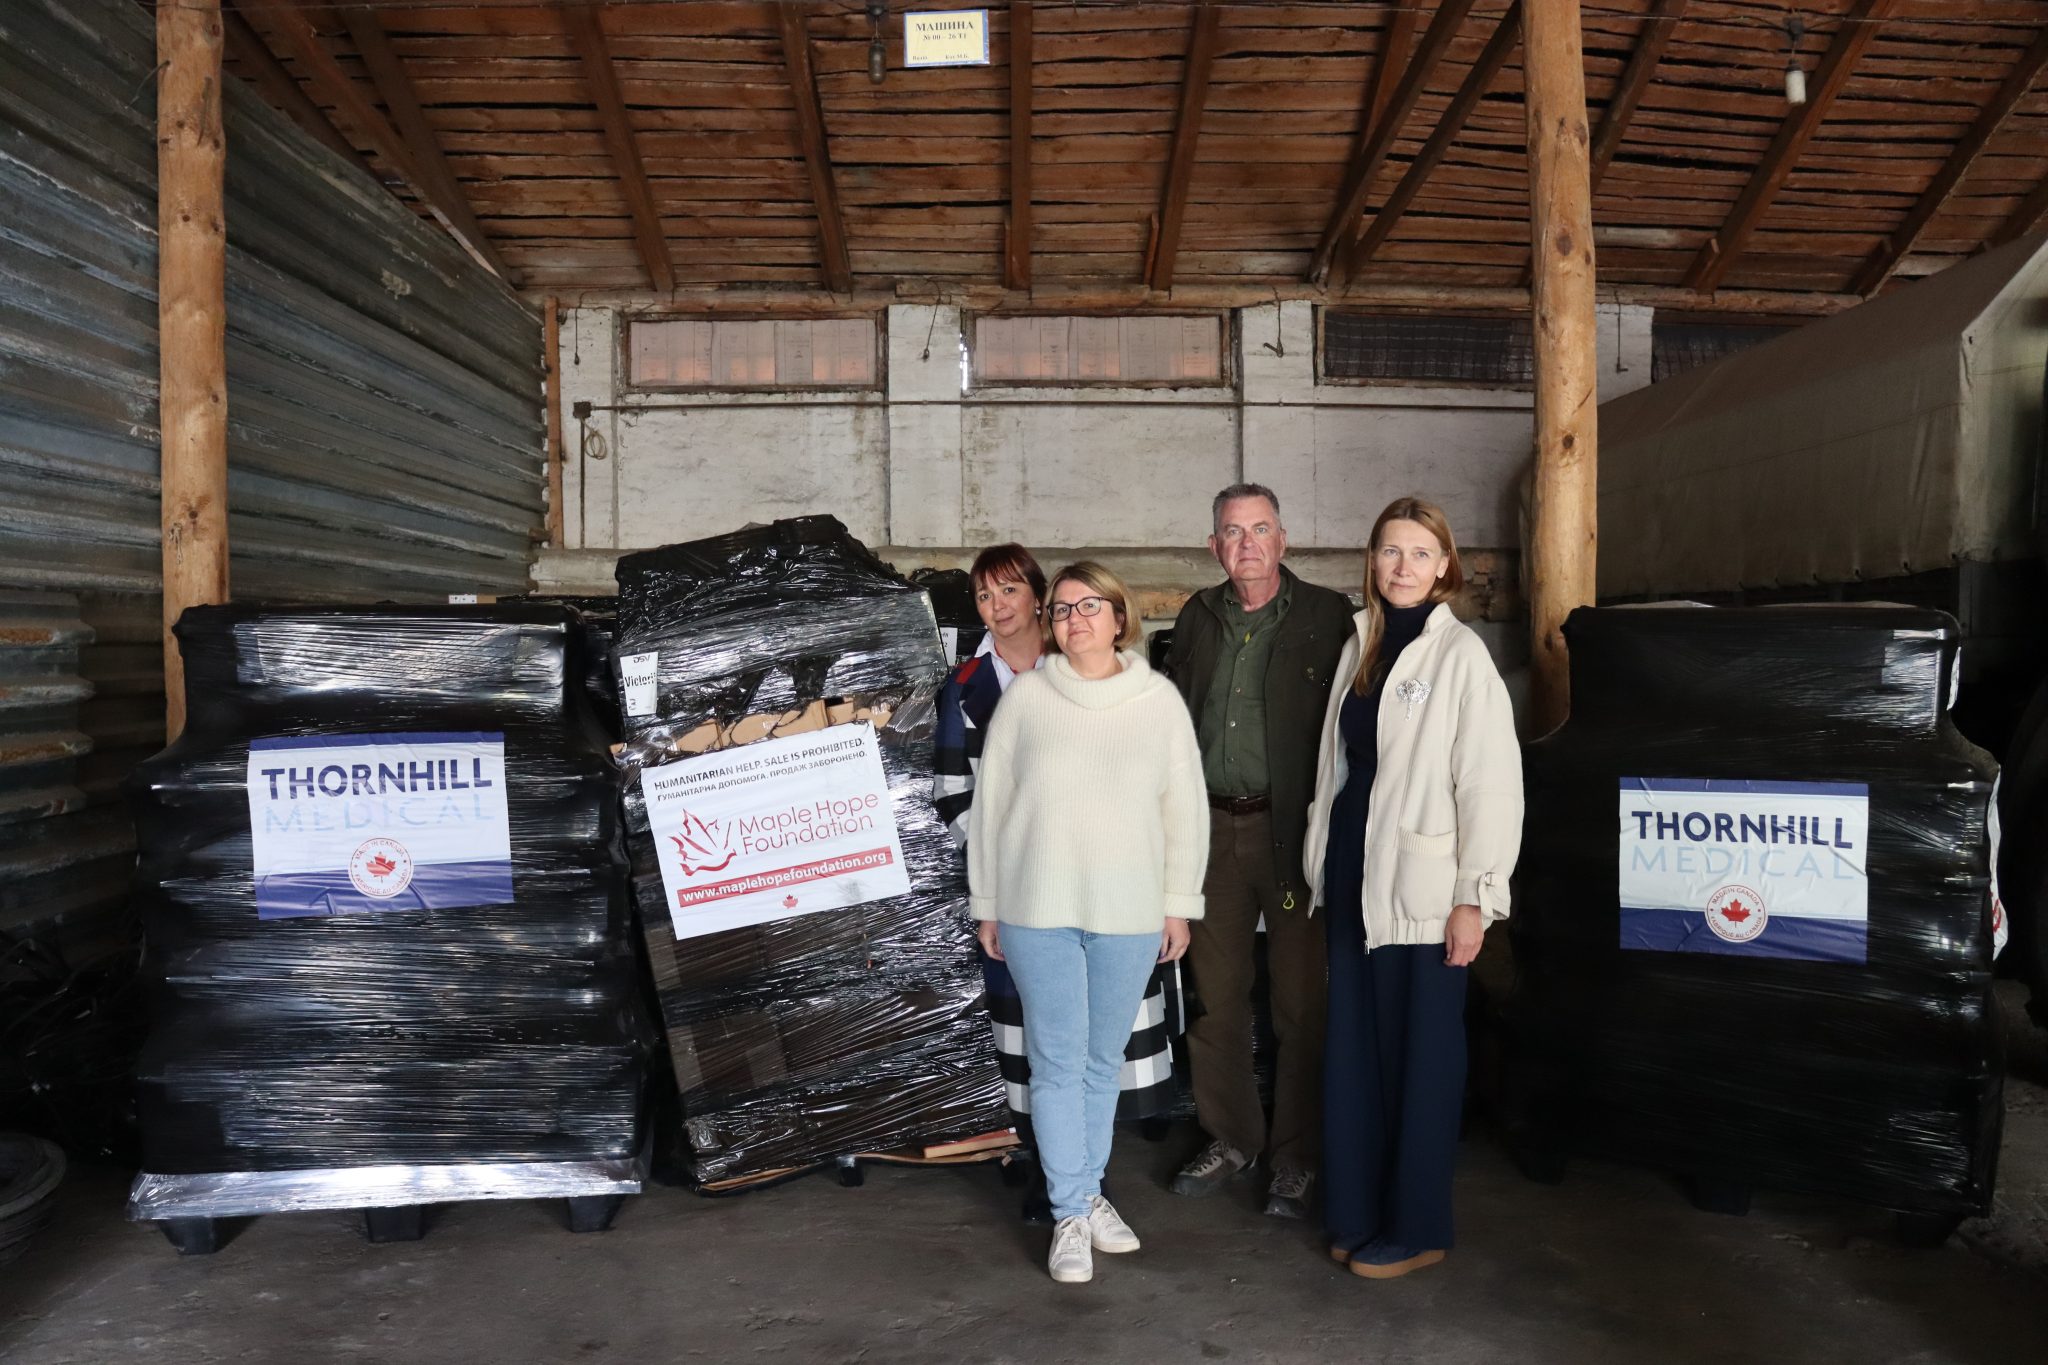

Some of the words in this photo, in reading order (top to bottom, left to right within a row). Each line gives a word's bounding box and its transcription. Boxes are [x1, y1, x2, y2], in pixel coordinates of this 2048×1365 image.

[916, 21, 974, 31] МАШИНА
[633, 655, 650, 663] DSV
[261, 757, 492, 800] THORNHILL
[654, 766, 734, 790] HUMANITARIAN
[736, 760, 763, 773] HELP.
[764, 754, 789, 767] SALE
[790, 751, 800, 761] IS
[802, 738, 865, 759] PROHIBITED.
[657, 783, 717, 802] ГУМАНІТАРНА
[718, 773, 769, 790] ДОПОМОГА.
[769, 764, 807, 778] ПРОДАЖ
[808, 750, 868, 770] ЗАБОРОНЕНО.
[265, 793, 495, 834] MEDICAL
[739, 806, 813, 836] Maple
[815, 793, 879, 821] Hope
[1631, 811, 1853, 849] THORNHILL
[742, 814, 874, 855] Foundation
[682, 852, 887, 902] www.maplehopefoundation.org
[1632, 845, 1855, 880] MEDICAL
[1736, 888, 1760, 905] CANADA
[1745, 917, 1762, 936] CANADA
